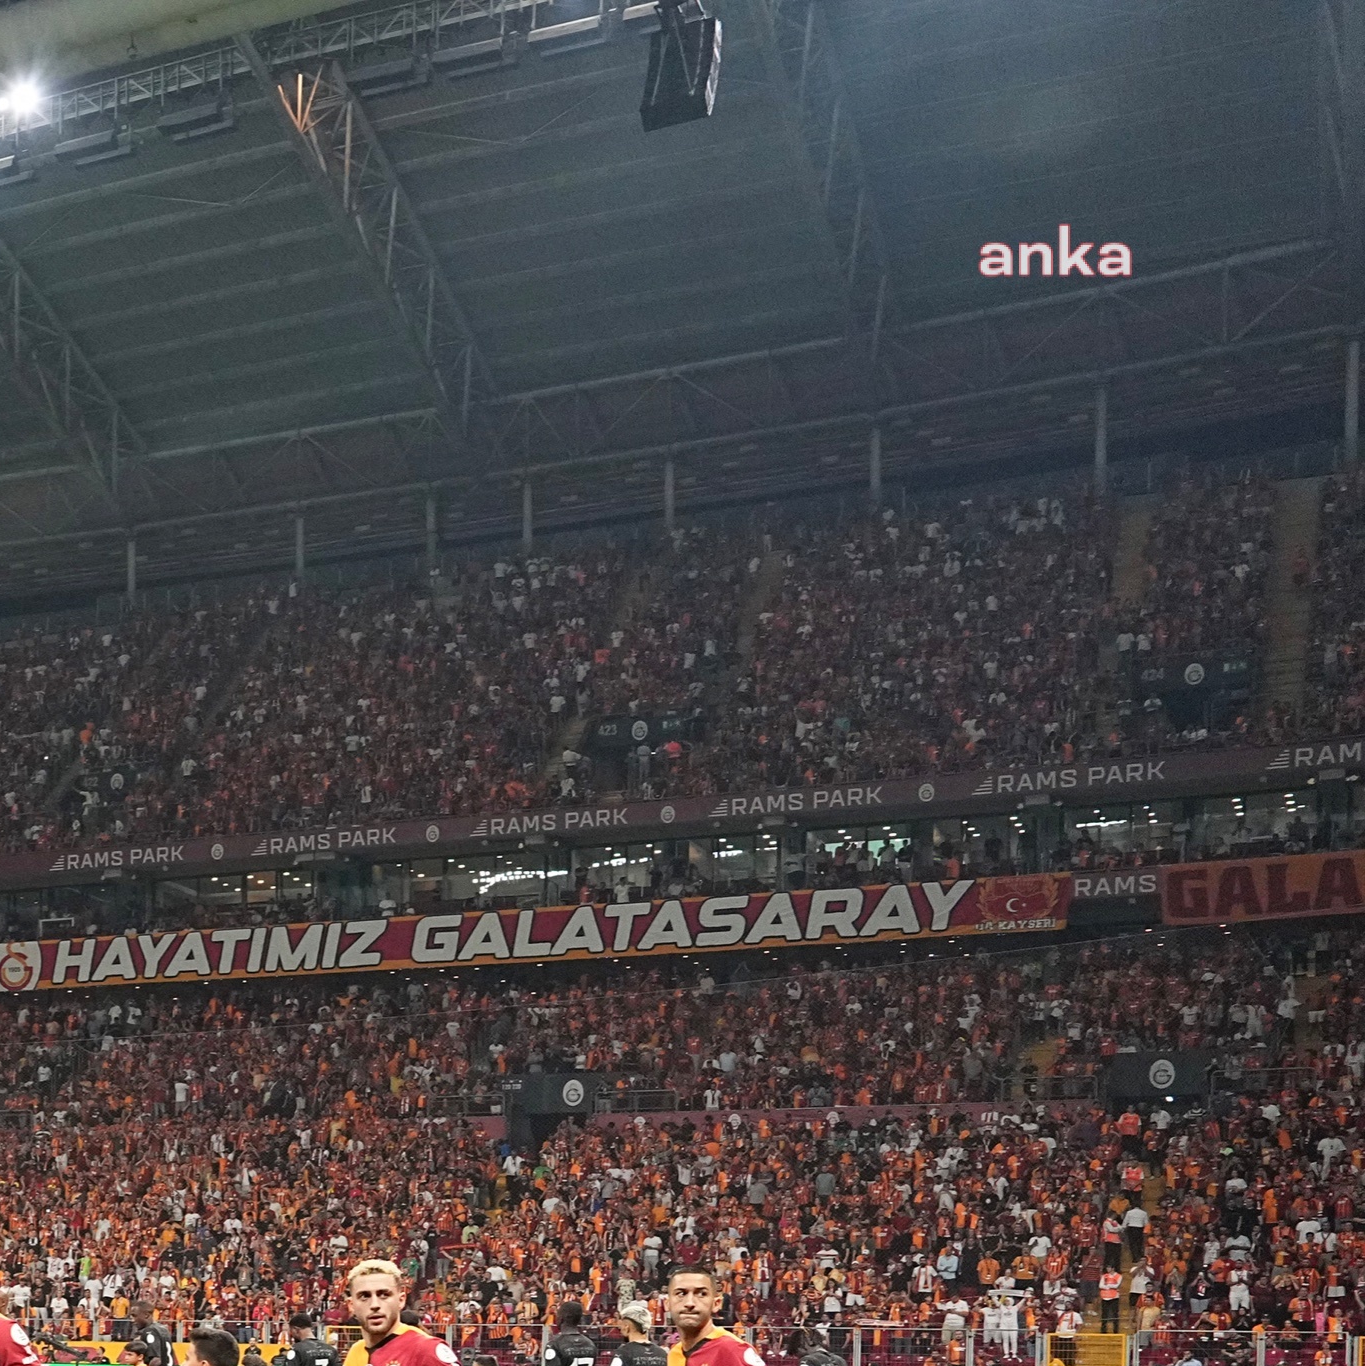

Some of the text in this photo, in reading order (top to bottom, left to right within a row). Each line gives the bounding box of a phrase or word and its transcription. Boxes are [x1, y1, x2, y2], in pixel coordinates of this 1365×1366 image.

[996, 760, 1167, 794] RAMS PARK
[731, 786, 883, 817] RAMS PARK
[489, 807, 629, 836] RAMS PARK
[270, 827, 397, 854] RAMS PARK
[67, 845, 185, 870] RAMS PARK
[1074, 874, 1157, 898] RAMS
[51, 878, 976, 984] HAYATIMIZ GALATASARAY
